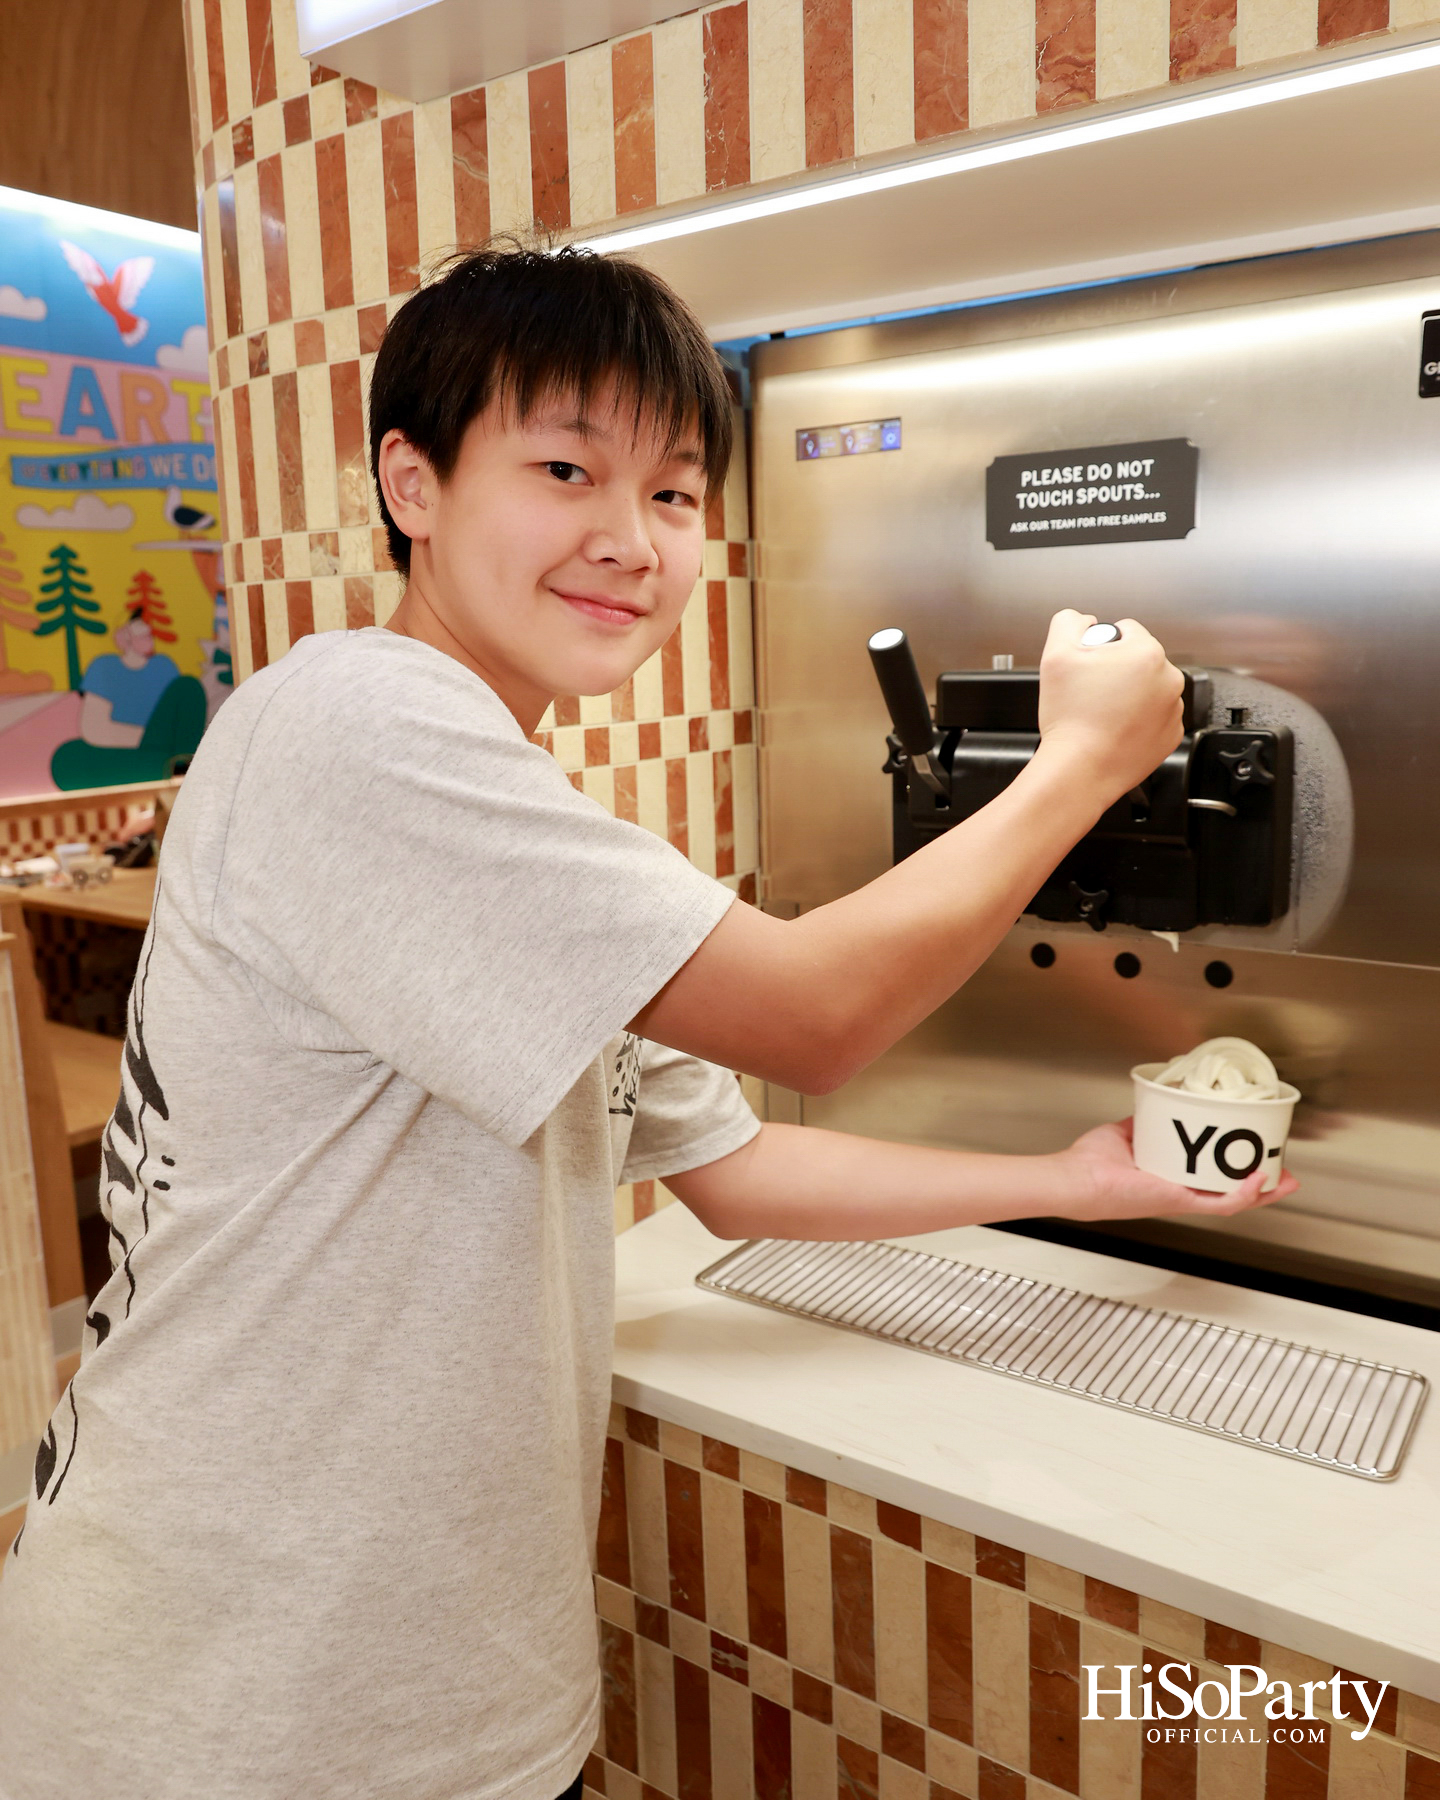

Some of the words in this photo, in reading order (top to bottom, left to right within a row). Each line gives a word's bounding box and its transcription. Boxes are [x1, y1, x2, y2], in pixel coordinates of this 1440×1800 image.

[40, 455, 146, 482] EVERYTHING
[151, 453, 187, 480] WE
[1021, 466, 1084, 488] PLEASE
[1087, 463, 1112, 482] DO
[1117, 459, 1155, 479] NOT
[1016, 489, 1073, 510] TOUCH
[1076, 483, 1161, 505] SPOUTS...
[1010, 522, 1028, 533] ASK
[1029, 520, 1049, 532] OUR
[1050, 518, 1076, 530] TEAM
[1077, 516, 1096, 529] FOR
[1097, 514, 1121, 527] FREE
[1121, 511, 1167, 525] SAMPLES
